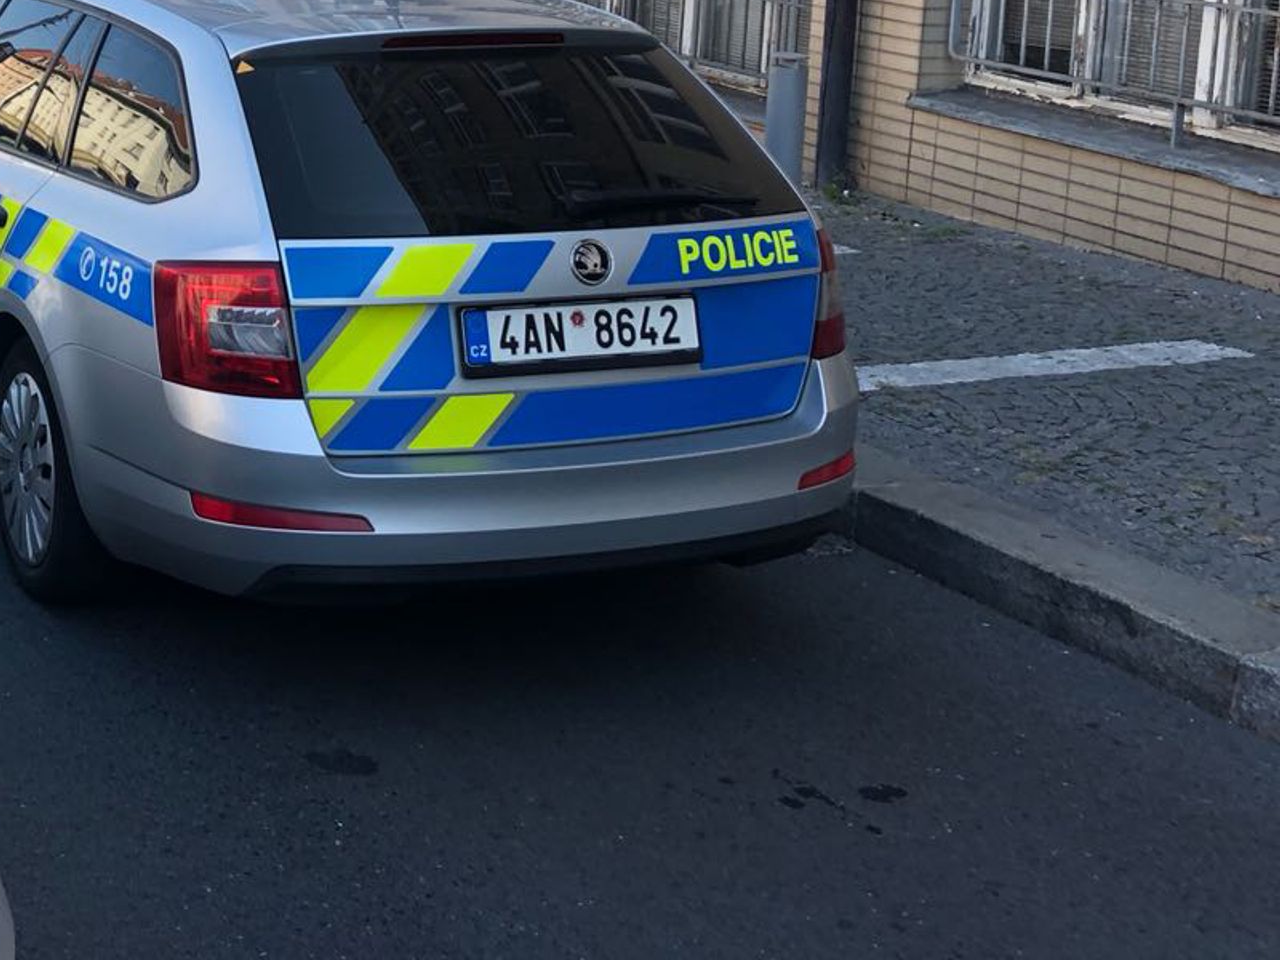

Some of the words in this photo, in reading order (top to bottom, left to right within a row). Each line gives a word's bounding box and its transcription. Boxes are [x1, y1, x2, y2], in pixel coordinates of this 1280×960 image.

[677, 229, 799, 275] POLICIE
[99, 256, 133, 300] 158
[470, 345, 488, 357] CZ
[499, 311, 566, 356] 4AN
[593, 304, 681, 349] 8642
